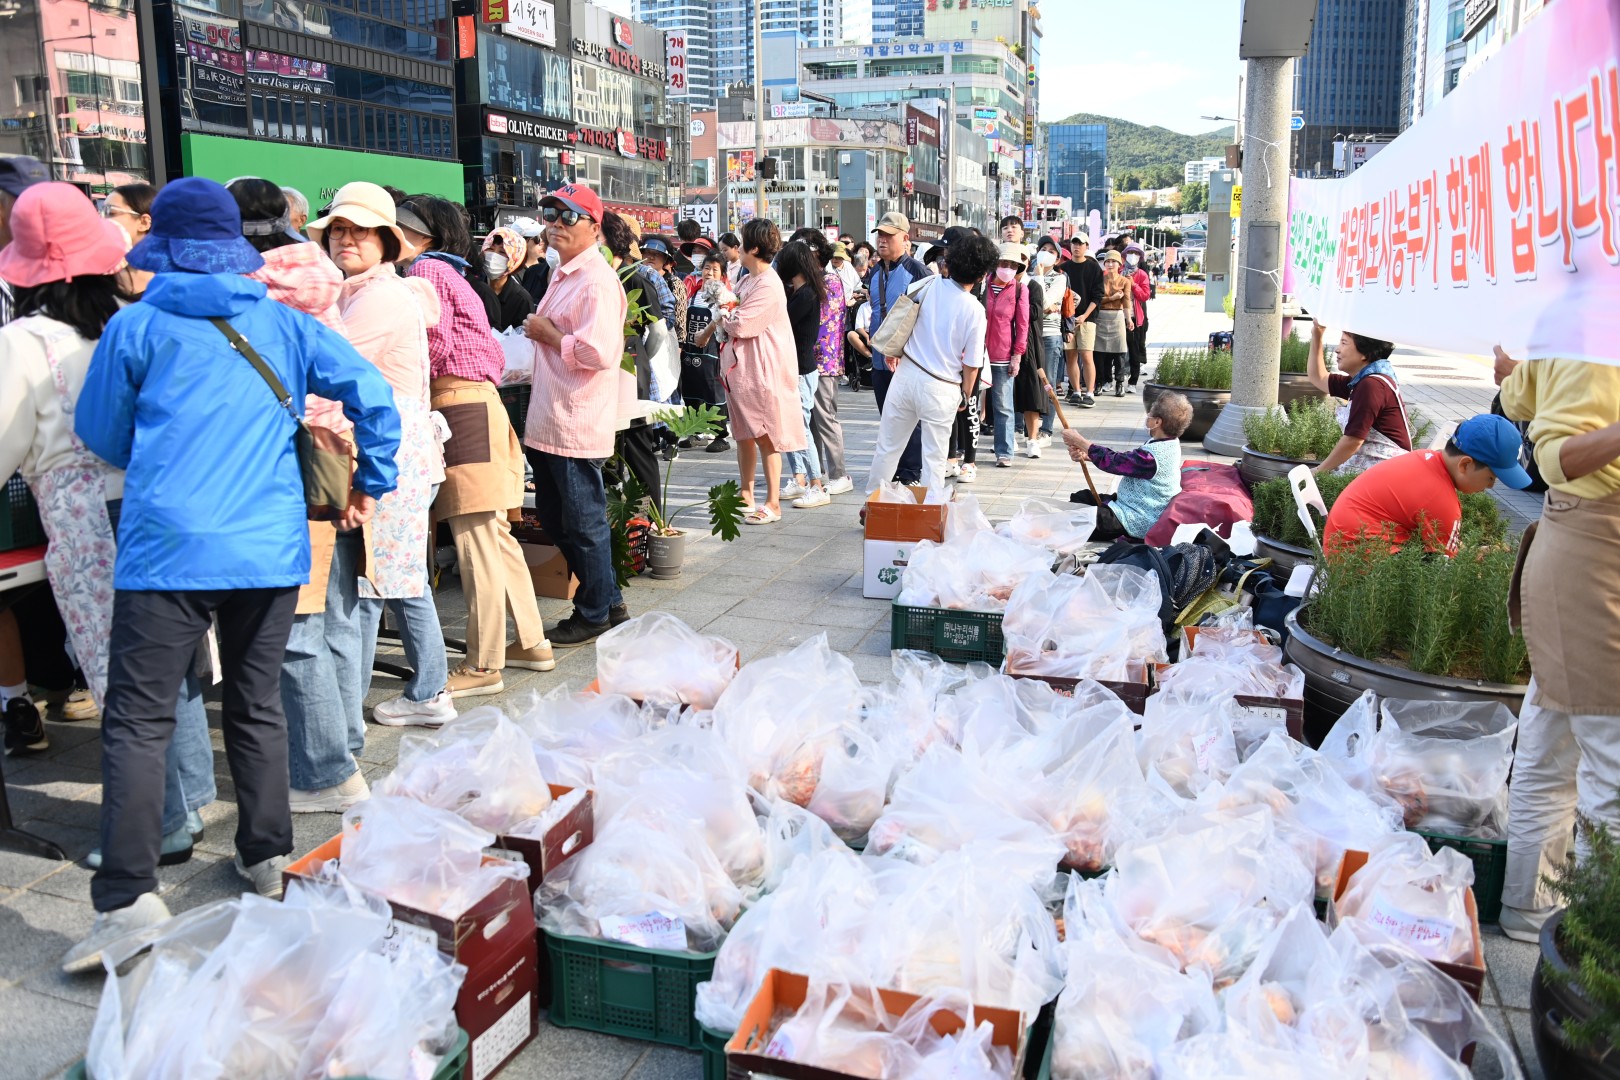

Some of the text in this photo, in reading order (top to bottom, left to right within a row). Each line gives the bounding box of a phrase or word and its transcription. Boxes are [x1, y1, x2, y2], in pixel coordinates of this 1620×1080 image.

[518, 26, 536, 37] MODERN
[576, 38, 666, 81] 국제시장 개미집 본점직영
[669, 37, 684, 89] 개미집
[508, 119, 533, 136] OLIVE
[534, 124, 568, 143] CHICKEN
[581, 127, 667, 161] 개미집 낙곱새
[562, 185, 577, 197] NY
[1337, 169, 1441, 289] 해운대도시농부가
[1446, 142, 1495, 281] 함께
[966, 395, 981, 449] adidas
